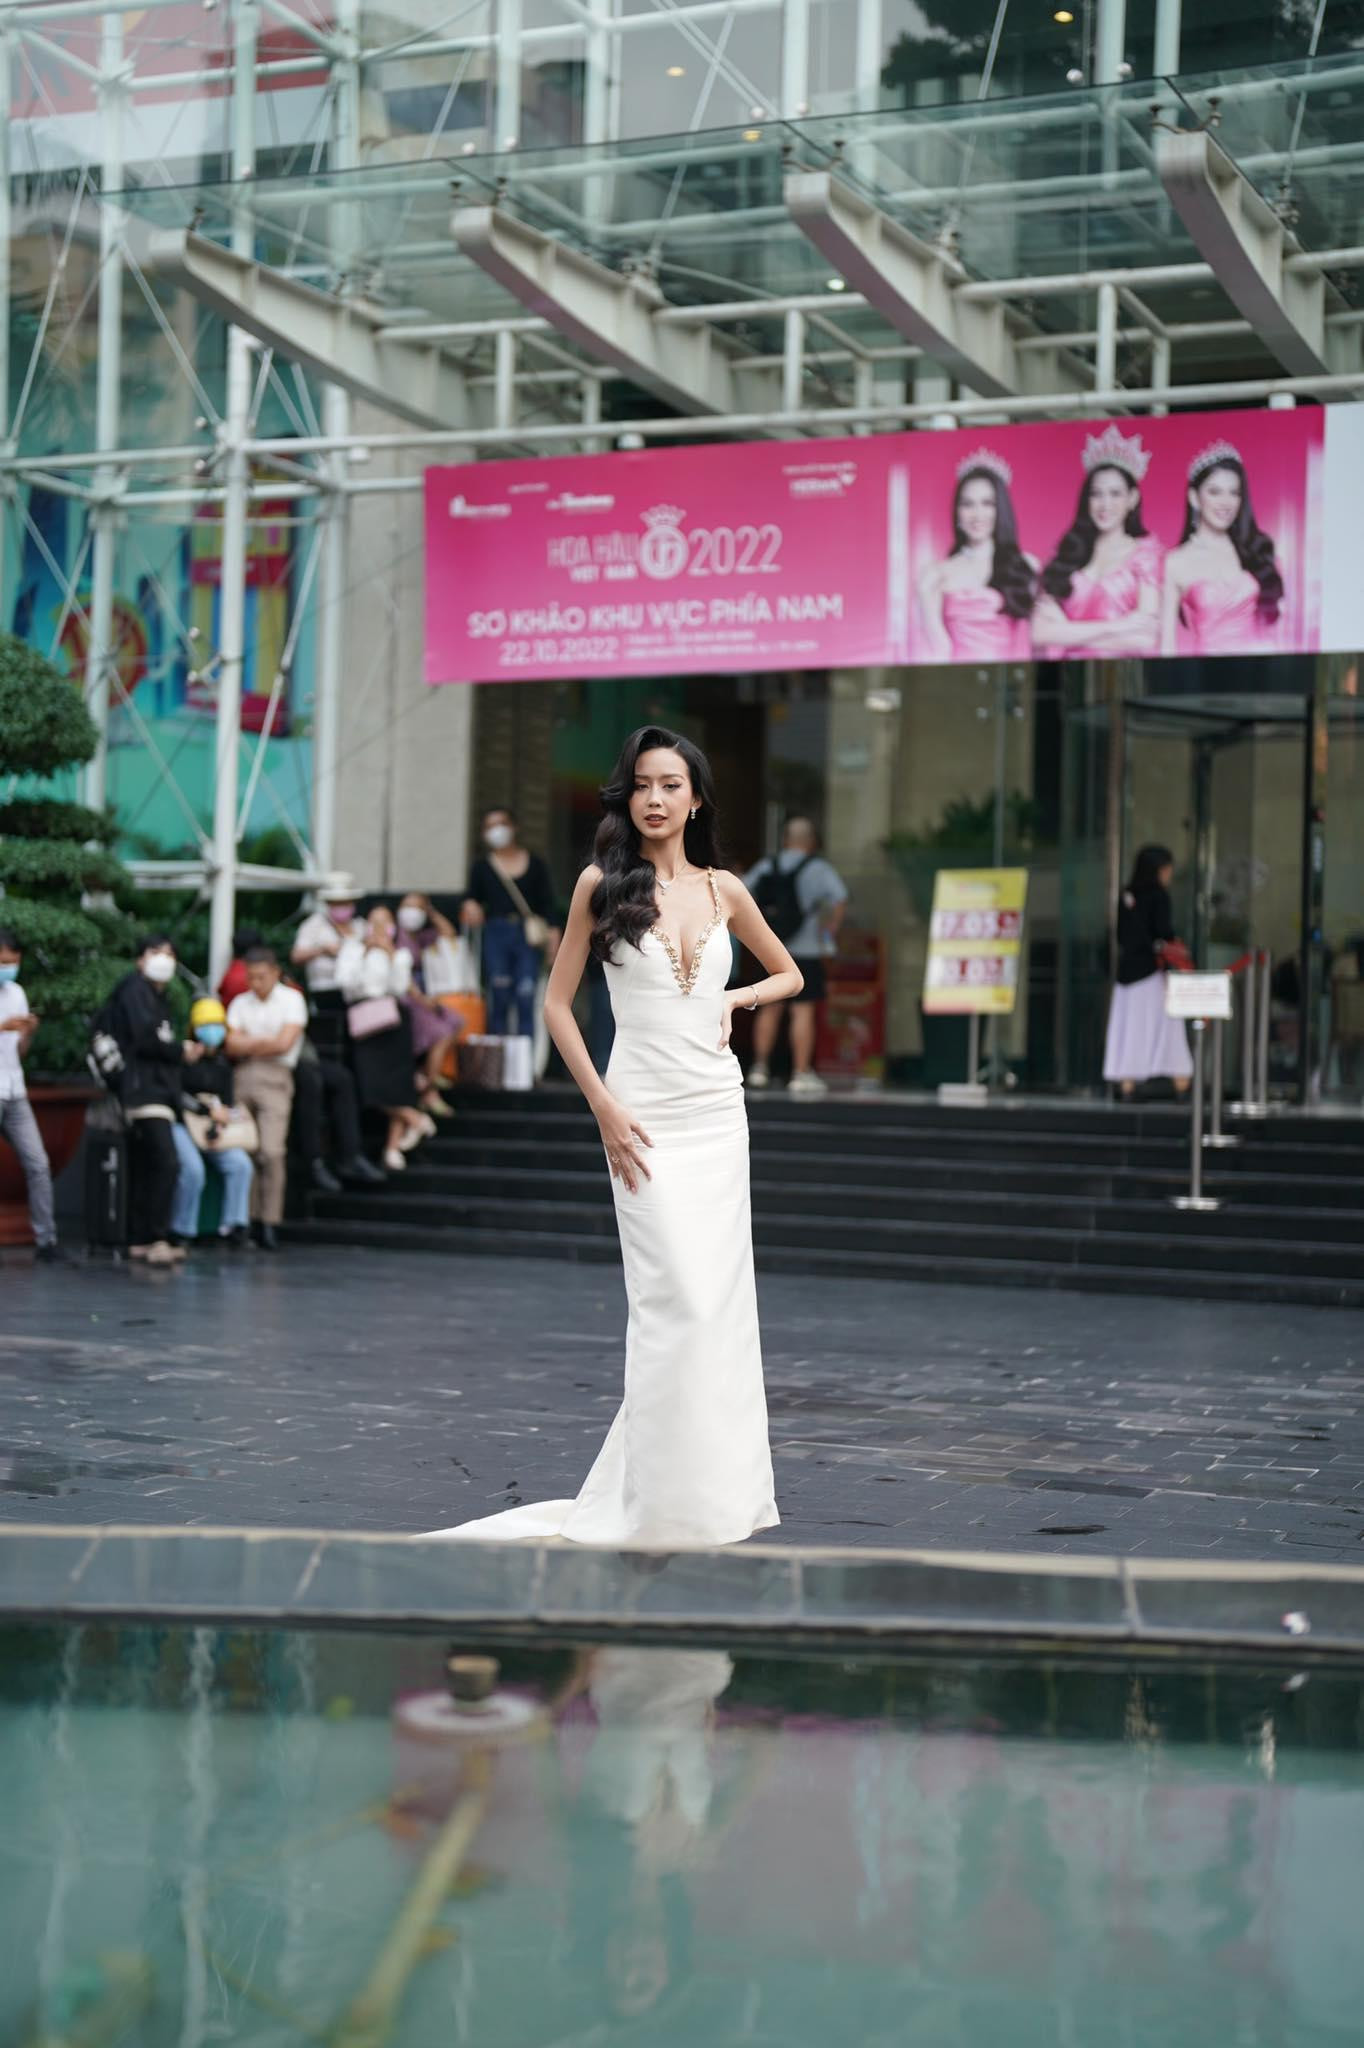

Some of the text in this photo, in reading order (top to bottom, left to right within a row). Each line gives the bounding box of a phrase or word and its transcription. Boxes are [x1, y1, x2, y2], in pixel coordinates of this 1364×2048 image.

[547, 536, 592, 568] HOA
[687, 523, 783, 576] 2022
[589, 604, 644, 631] KHU
[709, 592, 772, 624] PHÍA
[777, 593, 844, 622] NAM
[499, 635, 621, 666] 22.10.2022
